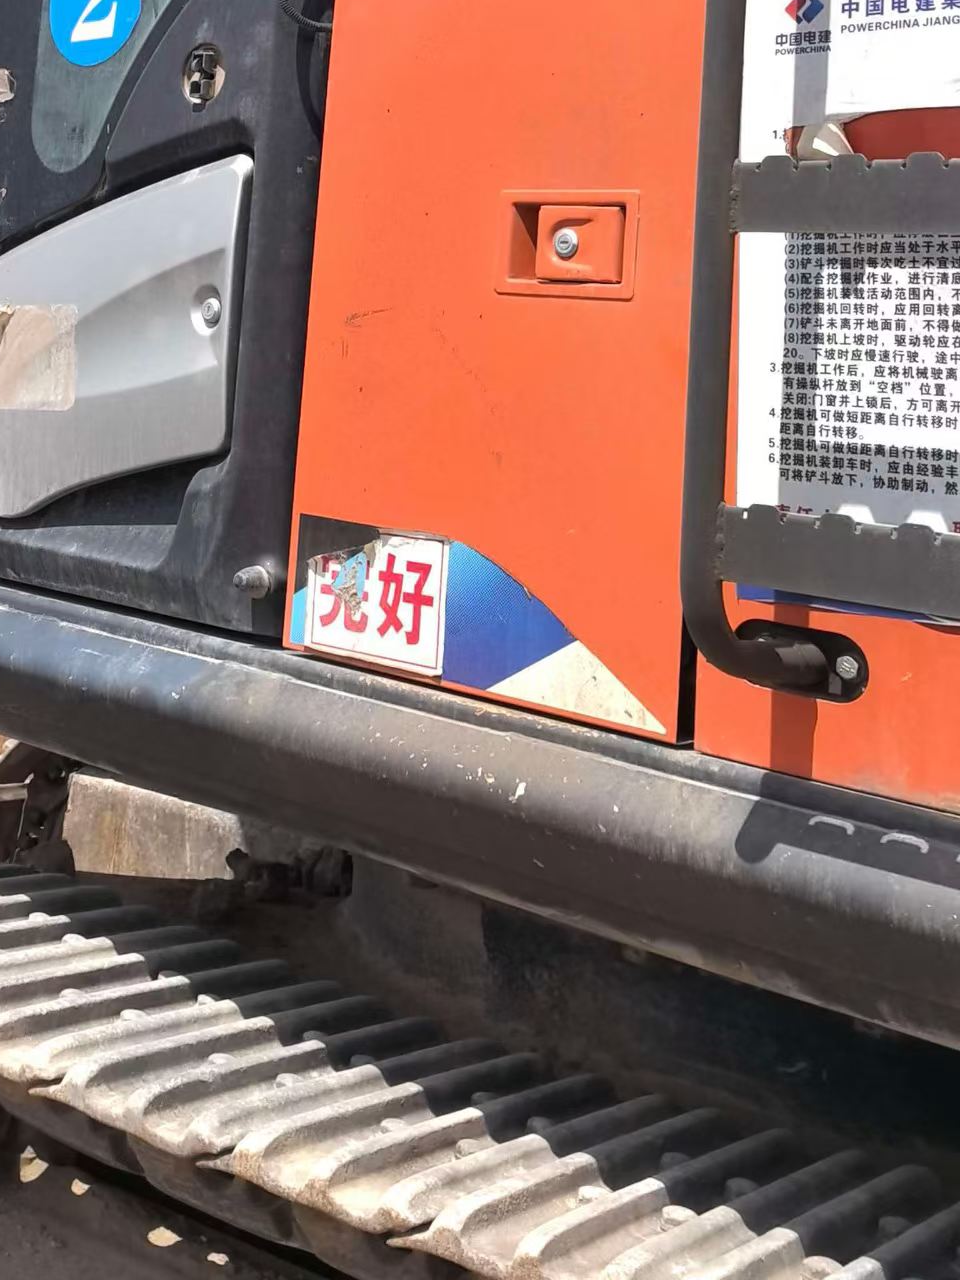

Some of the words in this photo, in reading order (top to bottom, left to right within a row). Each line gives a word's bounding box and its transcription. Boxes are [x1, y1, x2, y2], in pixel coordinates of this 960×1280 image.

[840, 19, 920, 34] POWERCHINA
[775, 30, 832, 47] 中国电建
[775, 45, 832, 56] POWERCHINA
[780, 422, 864, 440] 距离自行转移。
